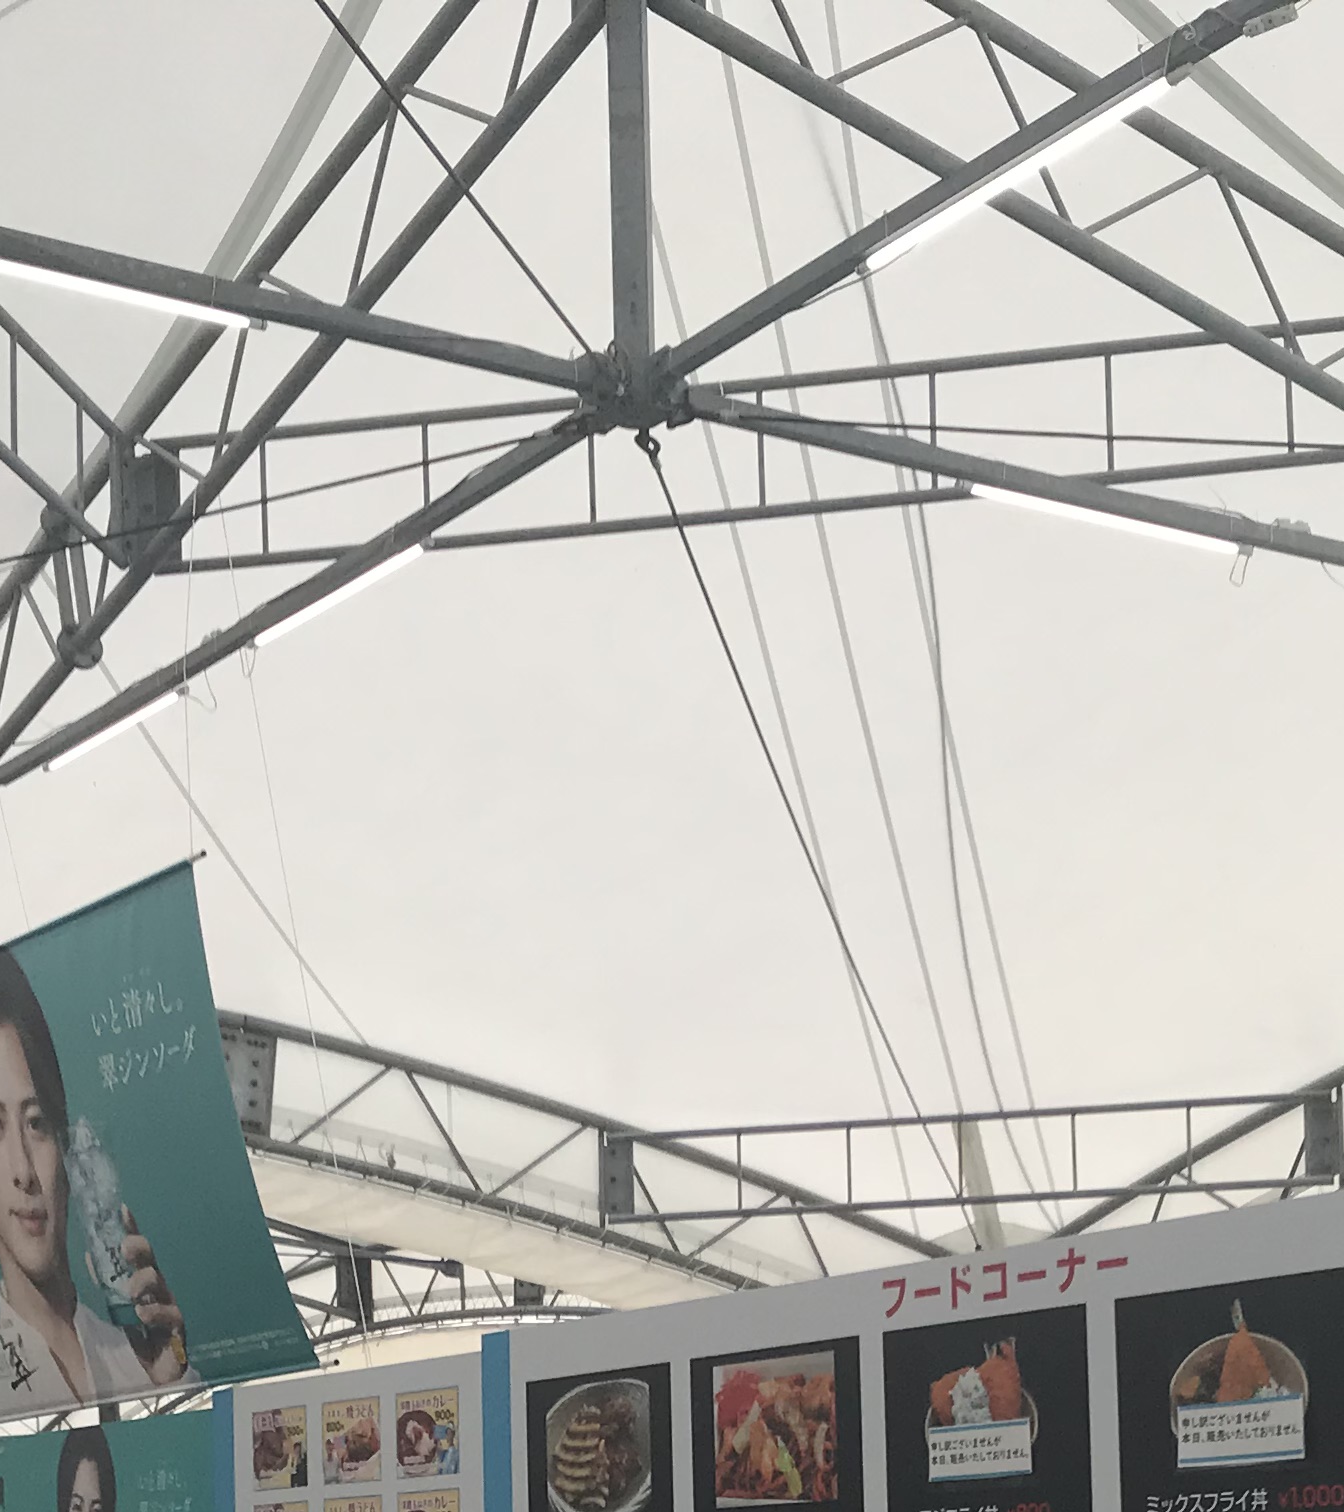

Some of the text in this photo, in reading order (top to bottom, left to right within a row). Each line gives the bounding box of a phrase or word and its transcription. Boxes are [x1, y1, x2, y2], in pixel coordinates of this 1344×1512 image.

[97, 1023, 197, 1094] 翠ジンソーダ
[881, 1246, 1129, 1319] フードコーナー
[1181, 1408, 1272, 1430] 申し訳ございませんが
[931, 1435, 1002, 1452] 申し訳ございませんが
[1181, 1423, 1303, 1444] 本日、販売いたしておりません。
